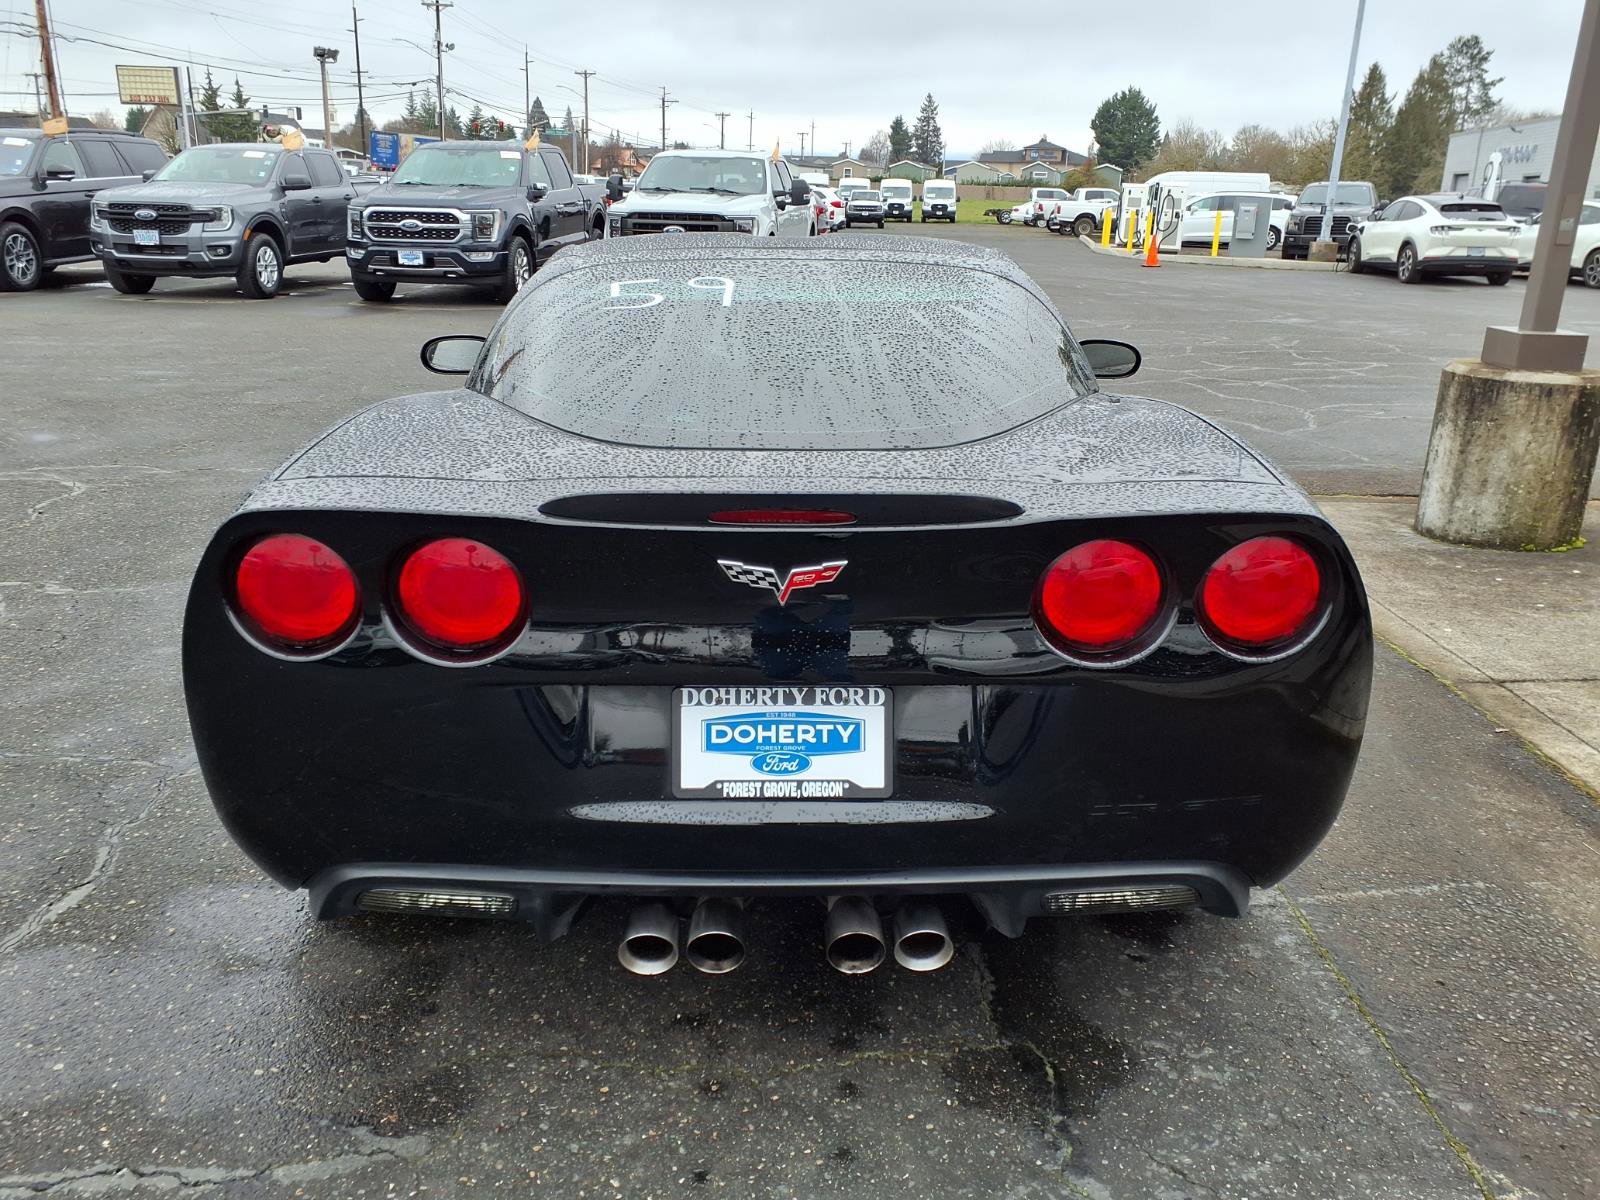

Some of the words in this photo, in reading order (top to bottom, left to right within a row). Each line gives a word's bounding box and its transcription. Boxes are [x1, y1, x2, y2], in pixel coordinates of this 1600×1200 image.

[600, 276, 735, 309] 59
[680, 687, 809, 707] DOHERTY
[814, 687, 886, 707] FORD
[710, 724, 856, 744] DOHERTY
[762, 754, 800, 772] Ford
[722, 782, 761, 798] FOREST
[763, 782, 801, 799] GROVE,
[803, 782, 844, 797] OREGON
